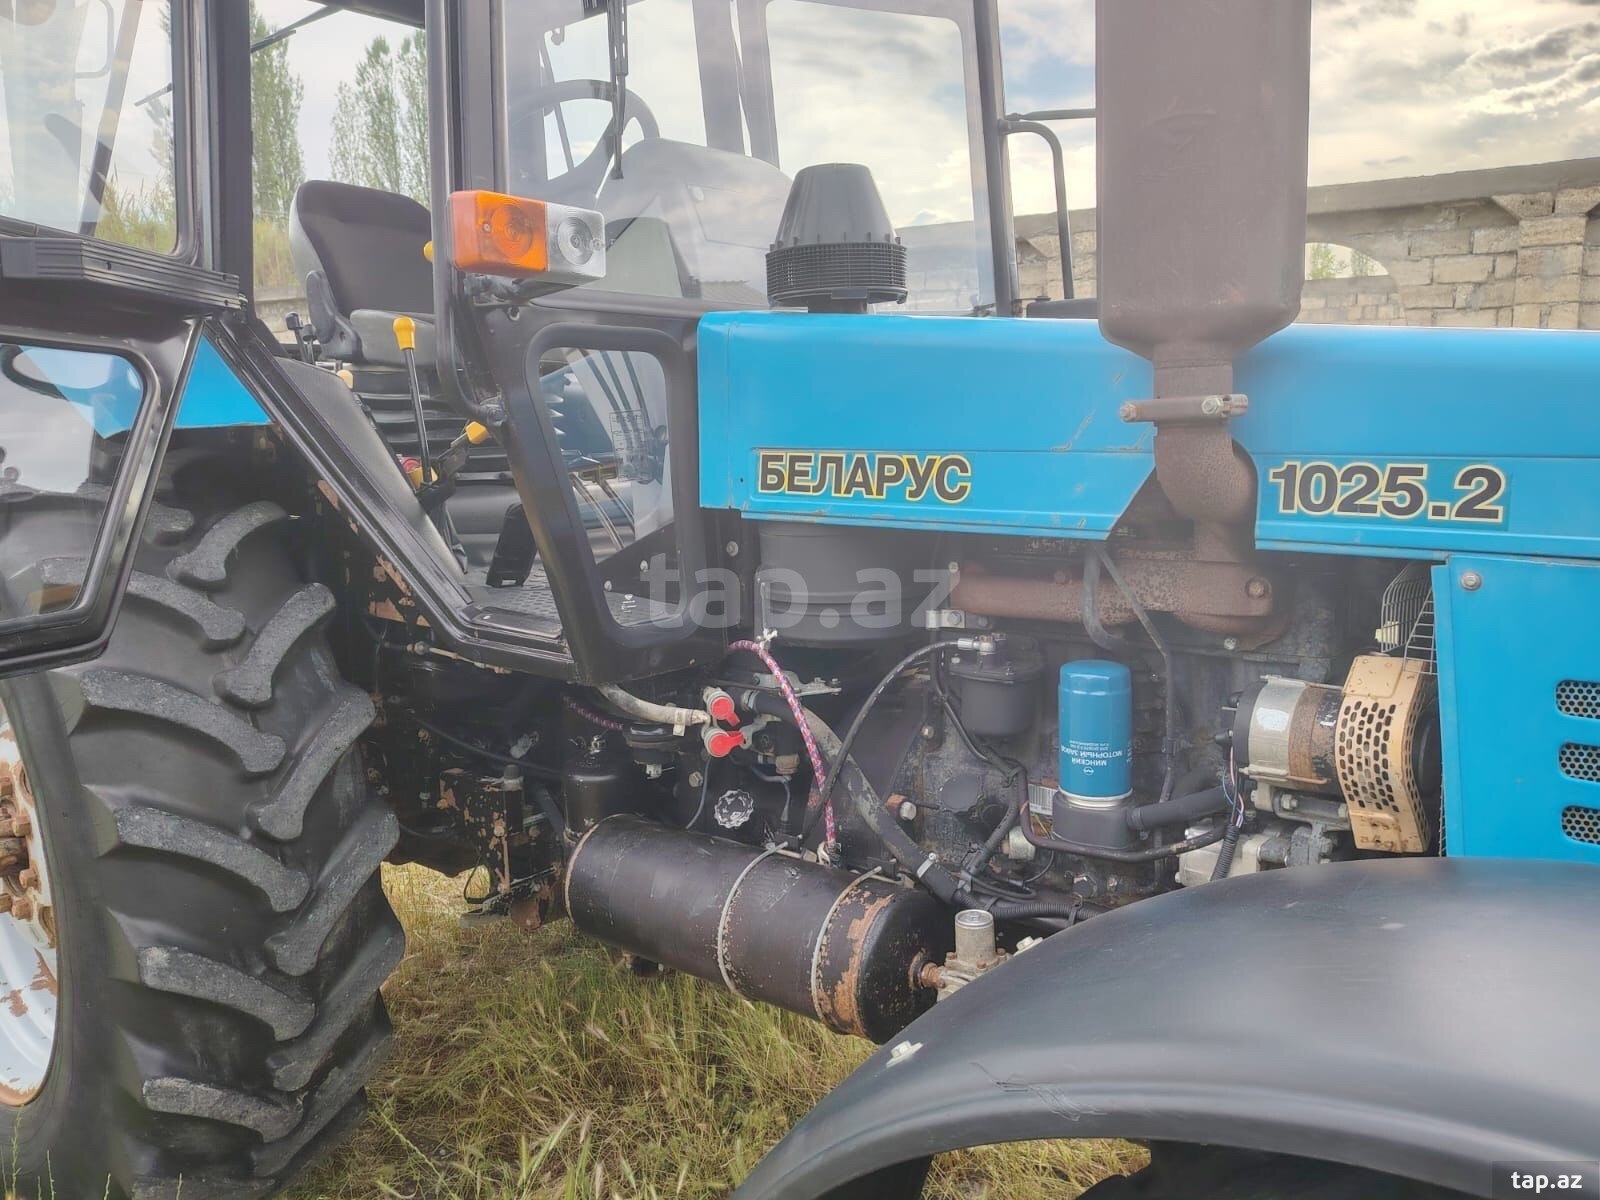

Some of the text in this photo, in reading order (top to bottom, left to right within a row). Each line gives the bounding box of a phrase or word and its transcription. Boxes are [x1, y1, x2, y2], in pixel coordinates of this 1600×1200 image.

[758, 452, 972, 503] БЕЛАРУС
[1269, 461, 1506, 523] 1025.2
[1071, 757, 1106, 766] МИНСКИЙ
[1080, 750, 1122, 758] МОТОРНЫЙ
